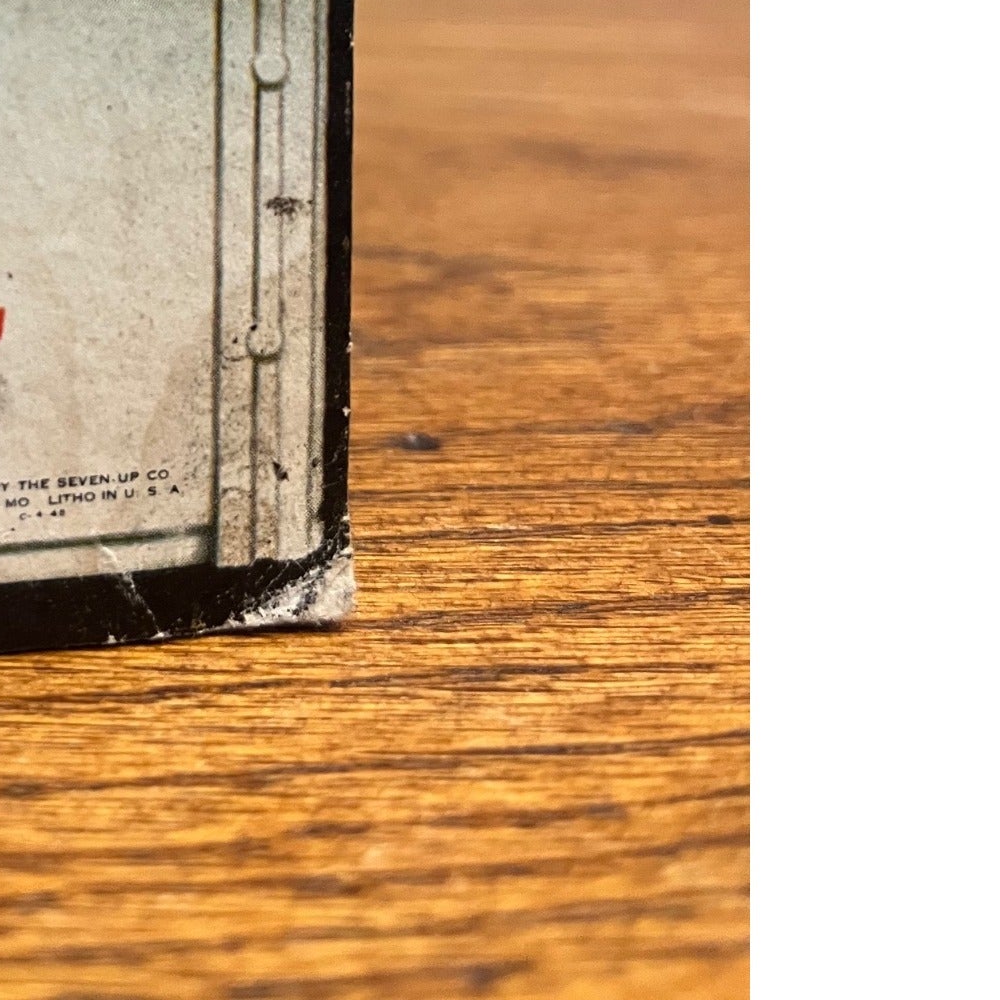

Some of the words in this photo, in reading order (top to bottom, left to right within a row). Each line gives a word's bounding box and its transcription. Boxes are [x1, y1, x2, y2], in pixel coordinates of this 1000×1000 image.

[18, 478, 50, 490] THE
[48, 491, 96, 505] LITHO
[101, 489, 118, 500] IN
